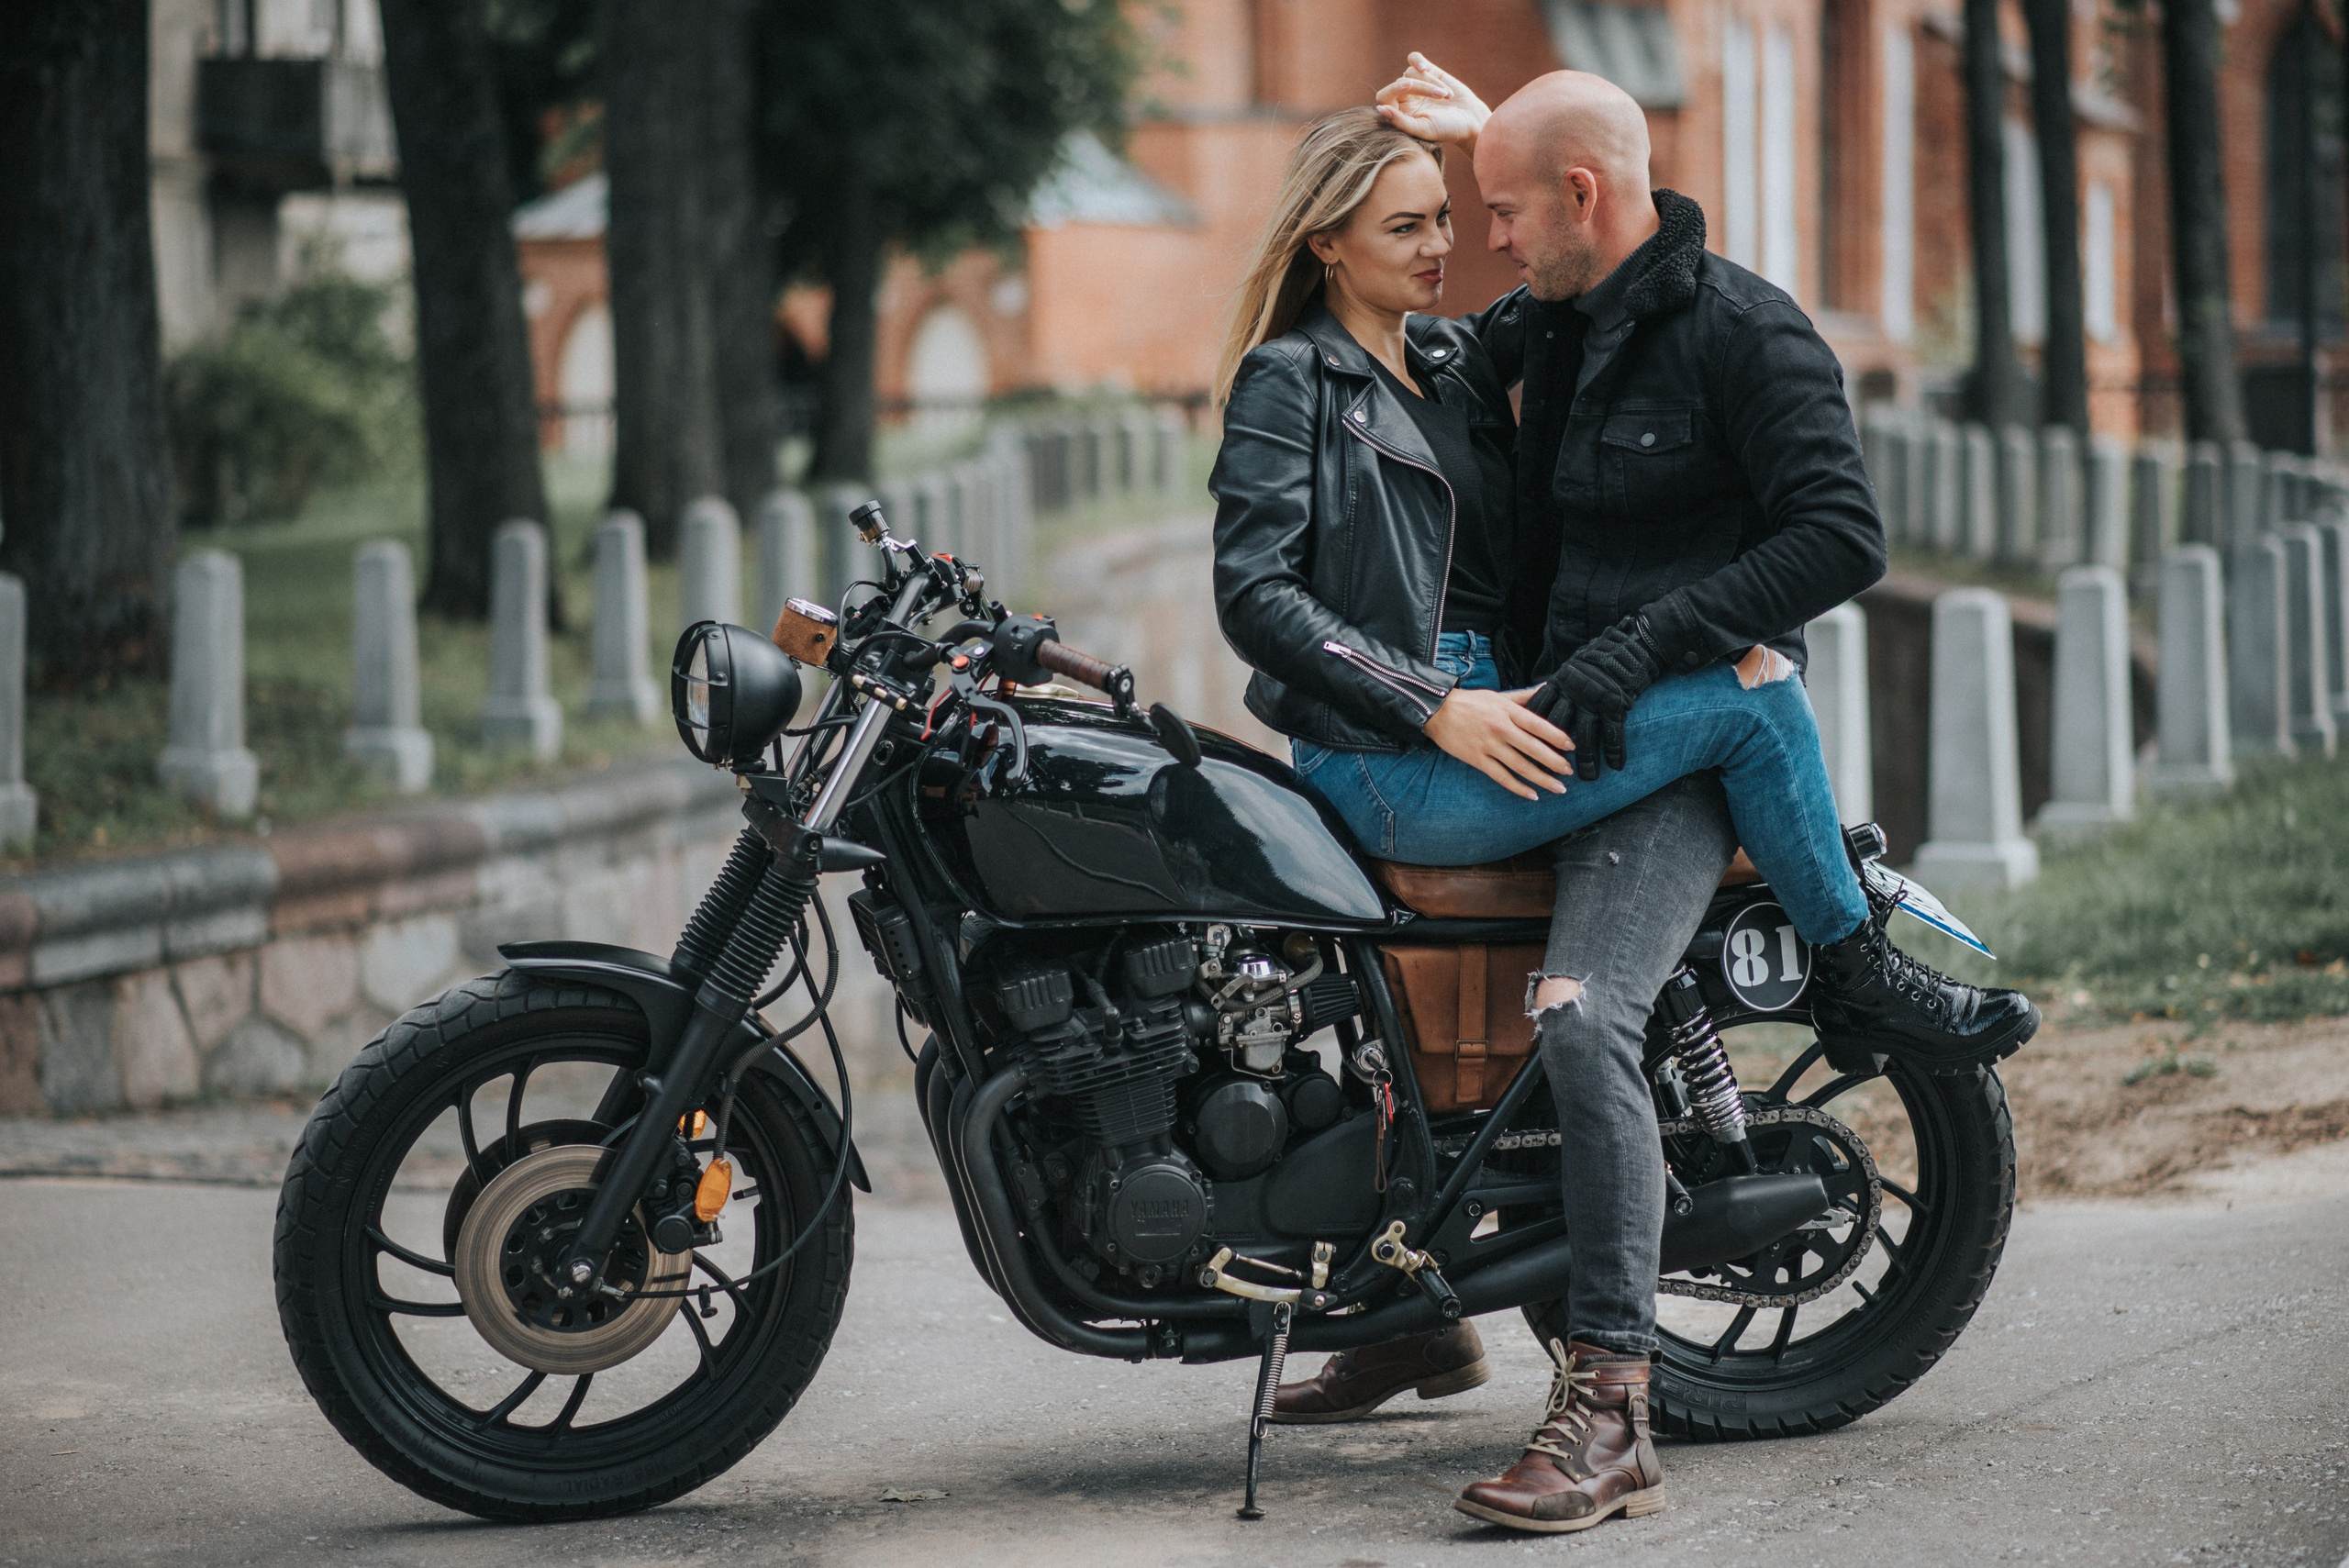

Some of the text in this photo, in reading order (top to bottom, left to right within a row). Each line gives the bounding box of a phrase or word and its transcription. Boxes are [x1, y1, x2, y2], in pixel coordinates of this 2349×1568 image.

[1731, 924, 1803, 987] 81
[1130, 1199, 1190, 1218] YAMAHA
[1649, 1368, 1747, 1412] PIREL
